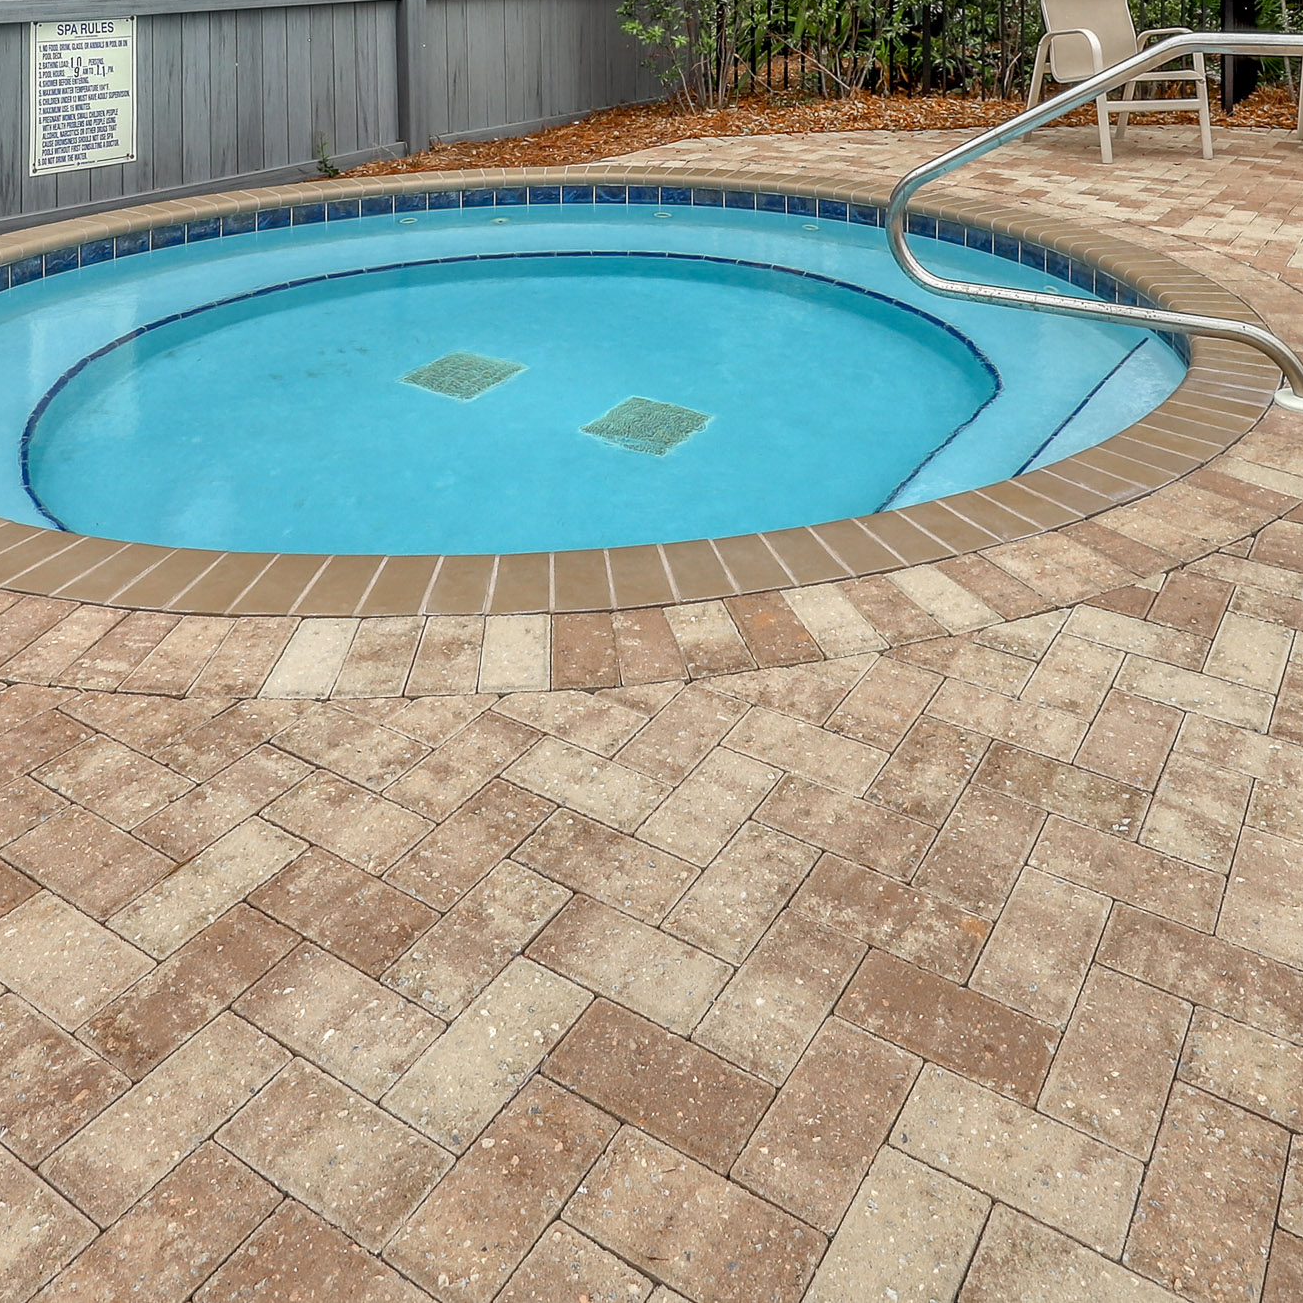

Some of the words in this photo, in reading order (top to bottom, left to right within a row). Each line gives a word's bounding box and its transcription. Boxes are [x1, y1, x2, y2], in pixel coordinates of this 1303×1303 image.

[57, 24, 78, 35] SPA
[80, 22, 114, 34] RULES
[71, 56, 82, 68] 10
[74, 67, 79, 77] 9
